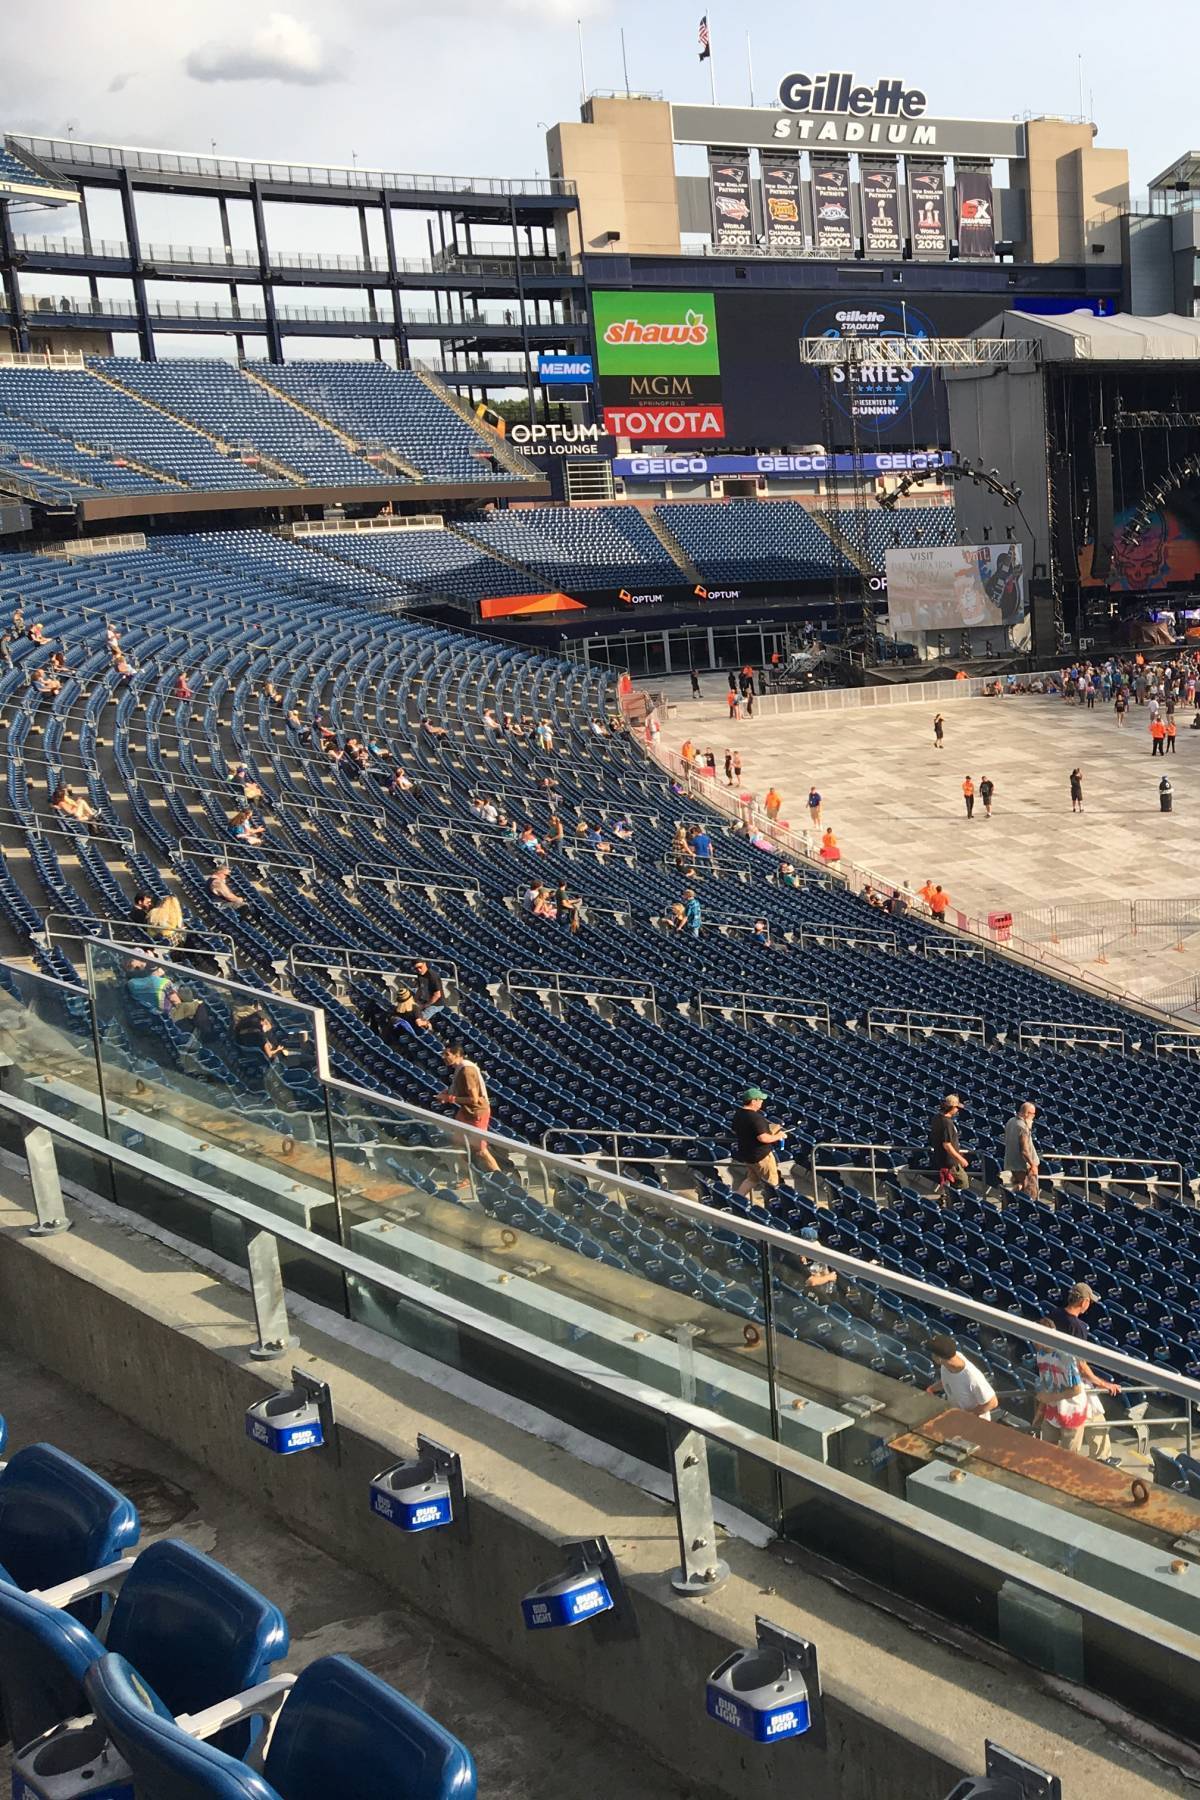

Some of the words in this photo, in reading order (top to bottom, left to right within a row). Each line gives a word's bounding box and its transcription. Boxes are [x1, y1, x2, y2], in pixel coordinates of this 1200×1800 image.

[779, 71, 928, 119] Gillette
[773, 118, 937, 145] STADIUM
[720, 235, 751, 245] 2001
[770, 236, 801, 245] 2003
[820, 238, 851, 247] 2004
[870, 239, 897, 249] 2014
[917, 240, 944, 249] 2016
[835, 311, 885, 322] Gillette
[541, 362, 591, 375] MEMIC
[630, 376, 693, 396] MGM
[608, 412, 721, 434] TOYOTA
[511, 424, 599, 443] OPTUM
[550, 444, 598, 454] LOUNGE
[630, 458, 708, 475] GEICO
[910, 551, 934, 561] VISIT
[632, 594, 662, 604] OPTUM
[707, 590, 739, 600] OPTUM
[291, 1430, 313, 1440] BUD
[287, 1436, 316, 1447] LIGHT
[416, 1506, 438, 1517] BUD
[412, 1511, 442, 1524] LIGHT
[575, 1590, 600, 1605] BUD
[573, 1596, 604, 1614] LIGHT
[770, 1711, 795, 1726] BUD
[766, 1718, 799, 1735] LIGHT
